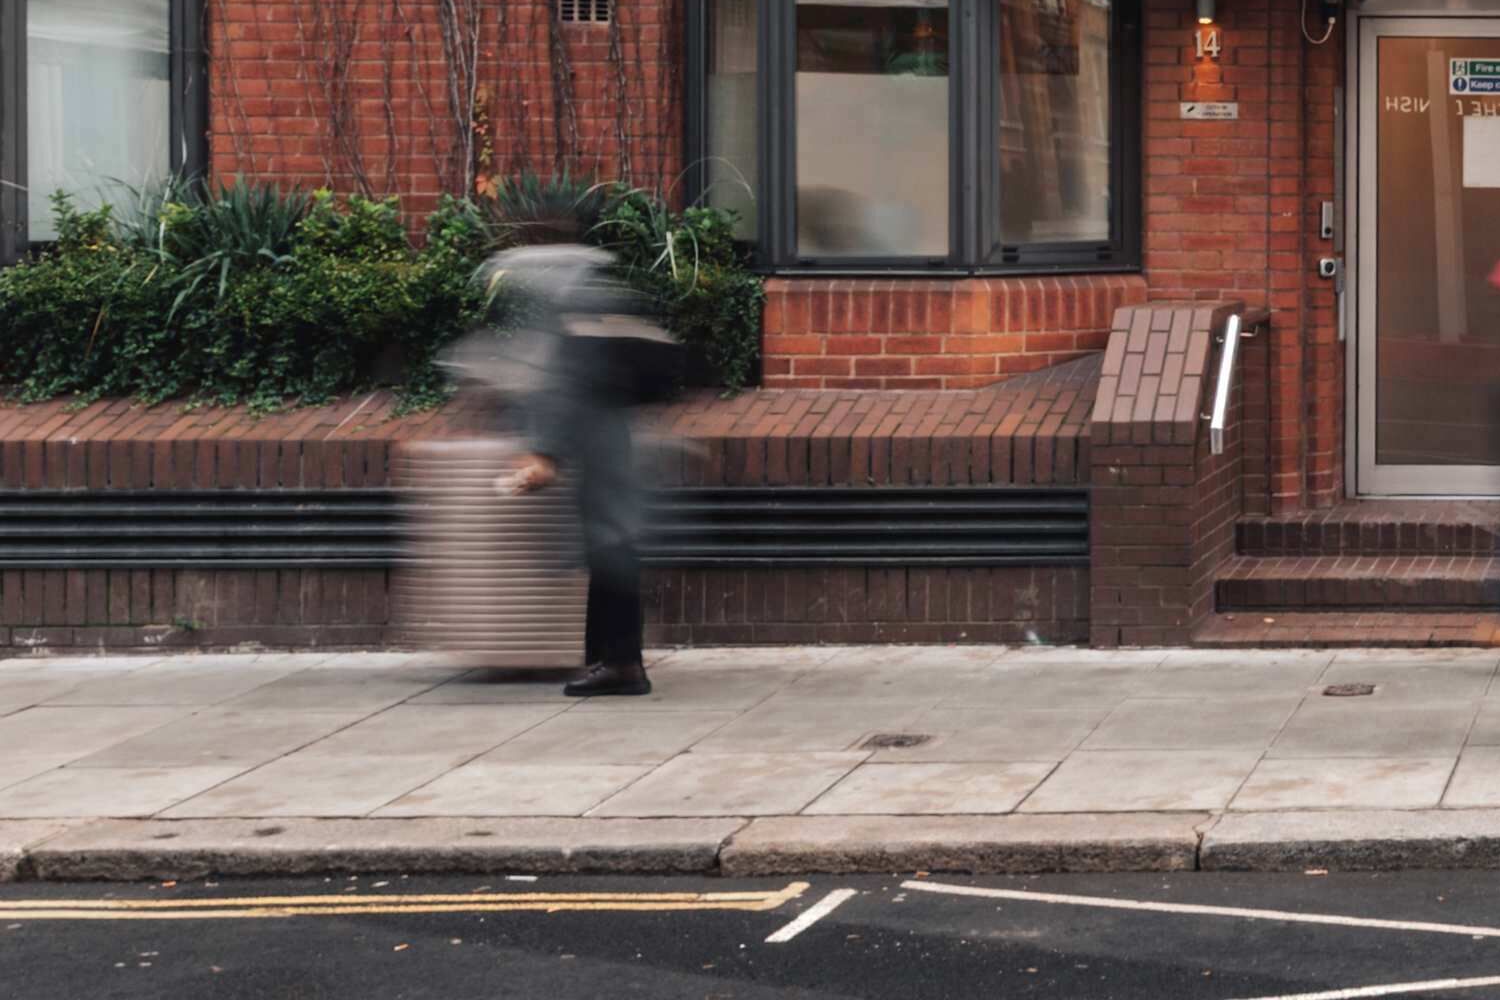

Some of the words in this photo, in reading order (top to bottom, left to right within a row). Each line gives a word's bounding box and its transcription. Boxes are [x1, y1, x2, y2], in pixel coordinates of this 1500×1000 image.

[1195, 30, 1221, 58] 14
[1475, 63, 1494, 73] Fire
[1470, 80, 1494, 91] Keep
